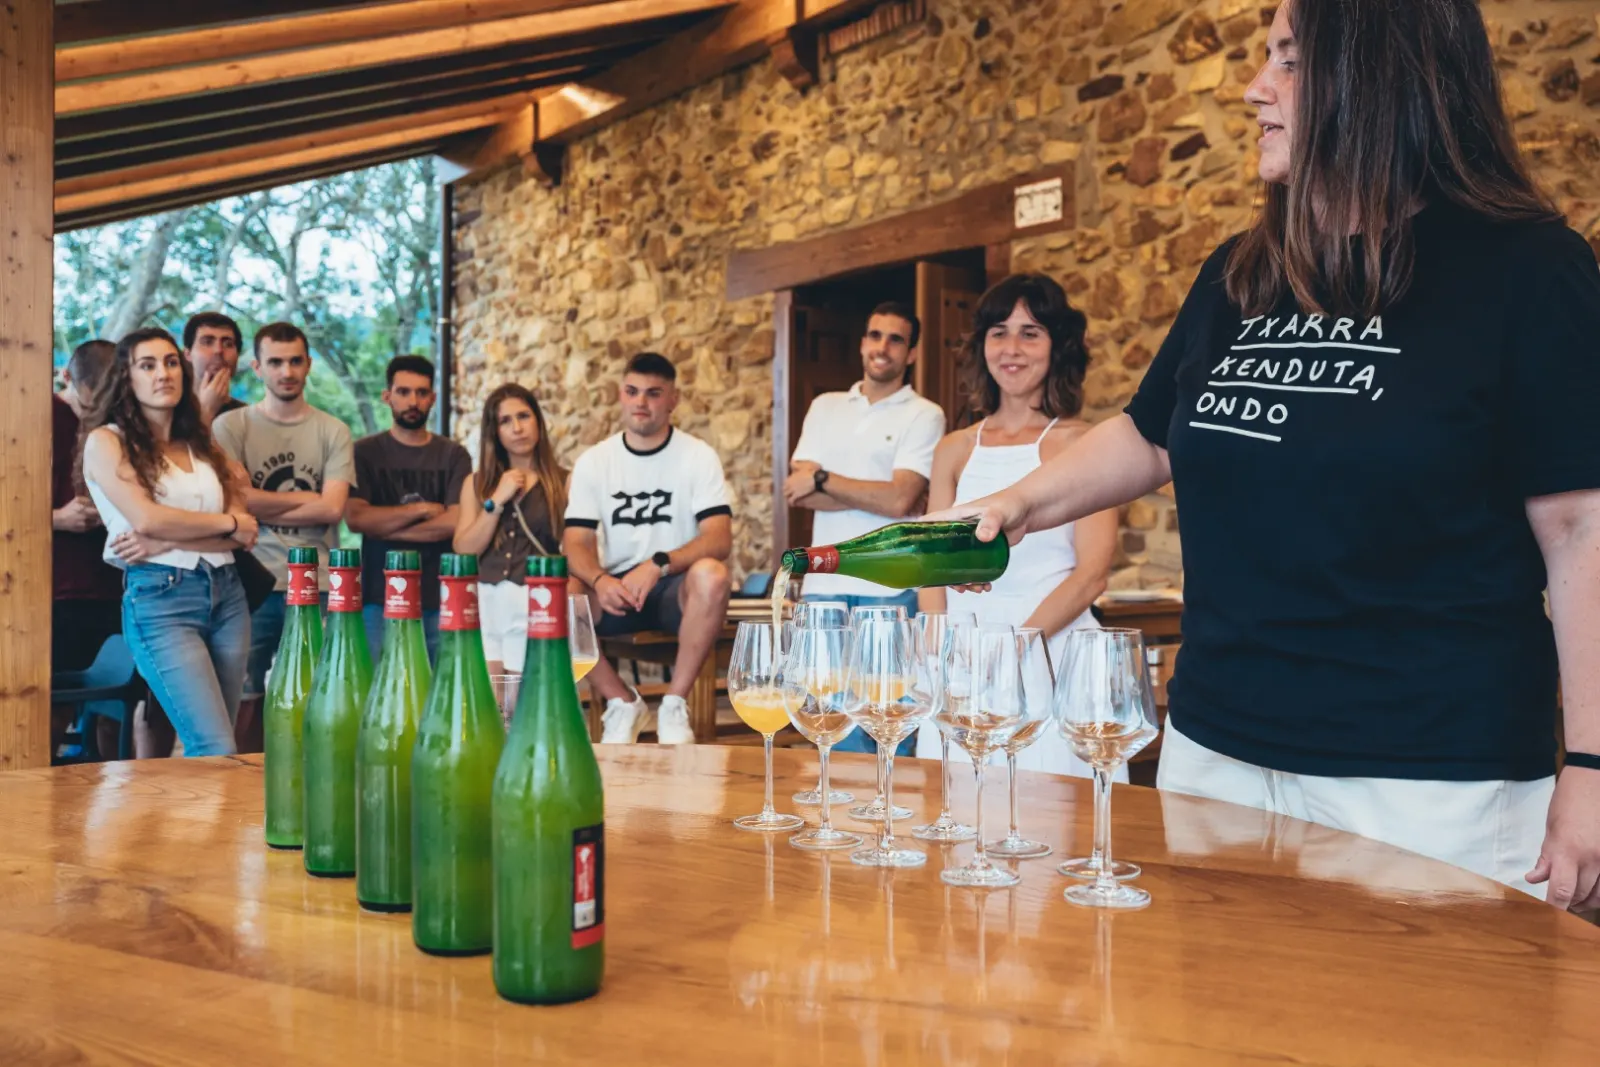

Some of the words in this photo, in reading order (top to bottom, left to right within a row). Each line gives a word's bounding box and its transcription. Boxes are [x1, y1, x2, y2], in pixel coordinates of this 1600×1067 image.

[1237, 313, 1383, 341] TXARRA
[1211, 356, 1384, 401] KENDUTA,
[1196, 392, 1288, 424] ONDO
[262, 451, 296, 471] 1990
[611, 489, 672, 527] 222
